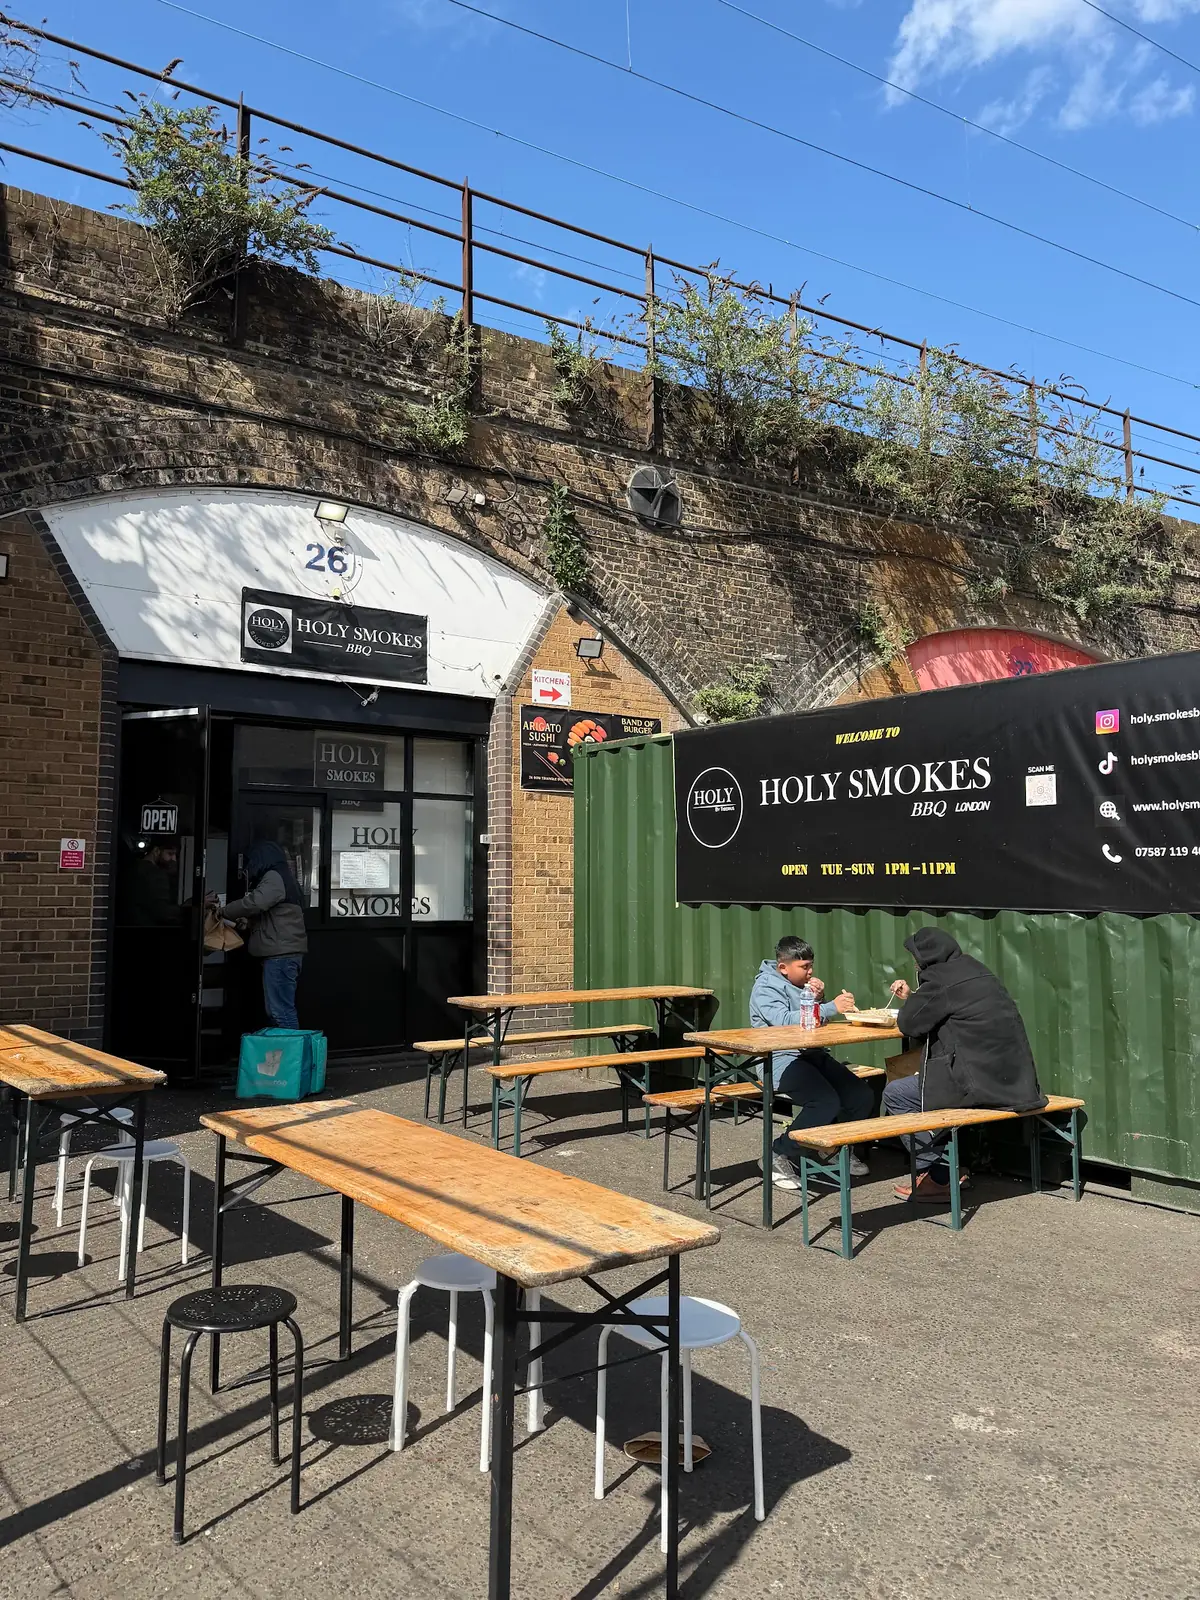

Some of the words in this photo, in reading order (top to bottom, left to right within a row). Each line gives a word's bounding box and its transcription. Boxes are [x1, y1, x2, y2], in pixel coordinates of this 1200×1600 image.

[305, 542, 348, 574] 26
[252, 616, 286, 629] HOLY
[296, 617, 350, 638] HOLY
[353, 627, 422, 649] SMOKES
[345, 643, 372, 657] BBQ
[522, 720, 562, 734] ARIGATO
[621, 718, 643, 728] BAND
[644, 720, 655, 728] OF
[623, 725, 653, 735] BURGER
[528, 731, 556, 743] SUSHI
[835, 728, 884, 745] WELCOME
[885, 726, 900, 739] TO
[319, 743, 381, 766] HOLY
[326, 768, 376, 783] SMOKES
[1027, 765, 1045, 774] SCAN
[1045, 764, 1055, 772] ME
[759, 771, 842, 806] HOLY
[848, 756, 992, 799] SMOKES
[693, 787, 734, 806] HOLY
[910, 800, 947, 817] BBQ
[954, 800, 991, 813] LONDON
[142, 808, 176, 831] OPEN
[1135, 847, 1166, 857] 07587
[1169, 846, 1189, 856] 119
[781, 864, 808, 876] OPEN
